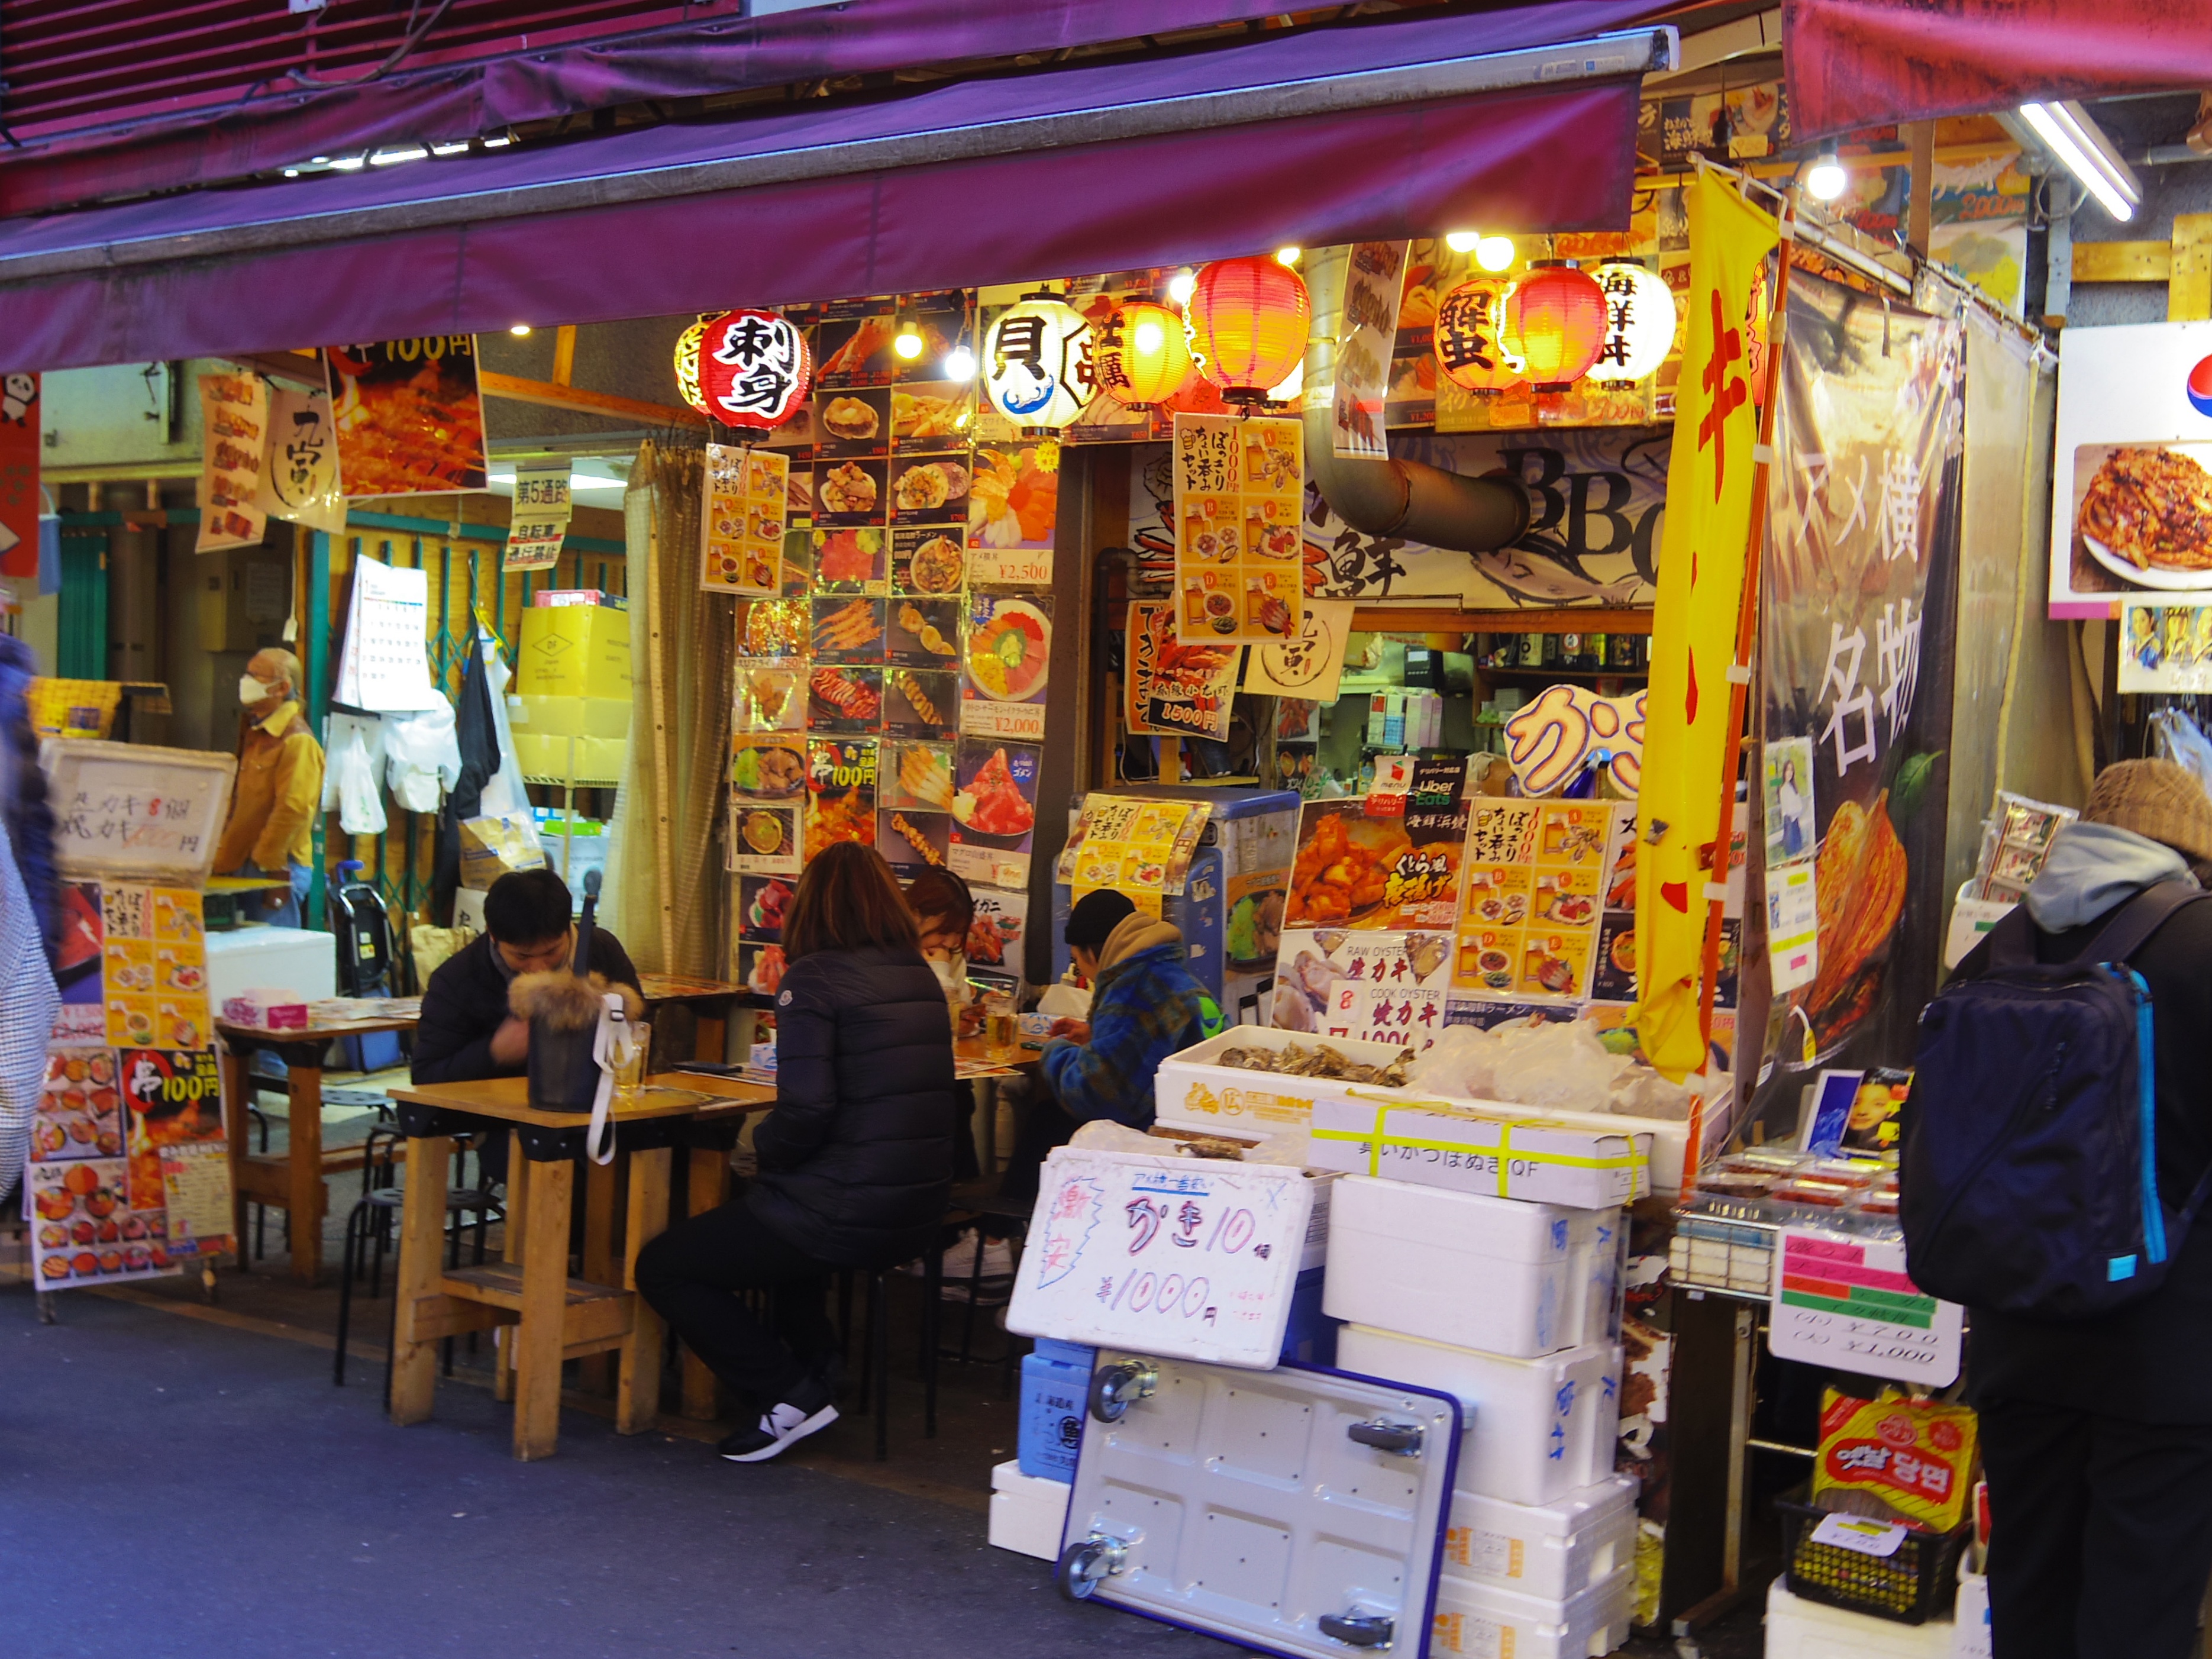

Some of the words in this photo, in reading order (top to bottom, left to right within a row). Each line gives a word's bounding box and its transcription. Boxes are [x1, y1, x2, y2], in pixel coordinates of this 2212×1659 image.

[993, 315, 1048, 380] 貝
[724, 317, 796, 414] 刺身
[1181, 453, 1197, 491] セット
[1195, 425, 1213, 492] ちょい呑み
[1211, 431, 1229, 492] ぽっきり
[517, 479, 570, 505] 第5通路
[518, 523, 556, 541] 自転車
[509, 544, 558, 563] 通行禁止
[999, 564, 1048, 580] ¥2,500
[1819, 598, 1923, 778] 名物
[994, 717, 1040, 734] ¥2,000
[1161, 703, 1219, 732] 1500円
[832, 766, 876, 787] 100円
[1419, 780, 1455, 792] Uber
[1416, 792, 1451, 806] Eats
[1472, 831, 1487, 861] セット
[1488, 806, 1506, 863] ちょい呑み
[1505, 811, 1530, 863] ぽっきり
[1383, 872, 1453, 908] 唐揚げ
[1348, 946, 1370, 957] RAW
[1348, 957, 1409, 982] 生カキ
[1340, 990, 1355, 1010] 8
[1371, 988, 1396, 999] COOK
[1399, 989, 1441, 1000] OYSTER
[1372, 998, 1439, 1028] 焼カキ
[162, 1074, 221, 1102] 100円
[1849, 1340, 1936, 1363] ¥1,000
[1893, 1450, 1951, 1495] 당면
